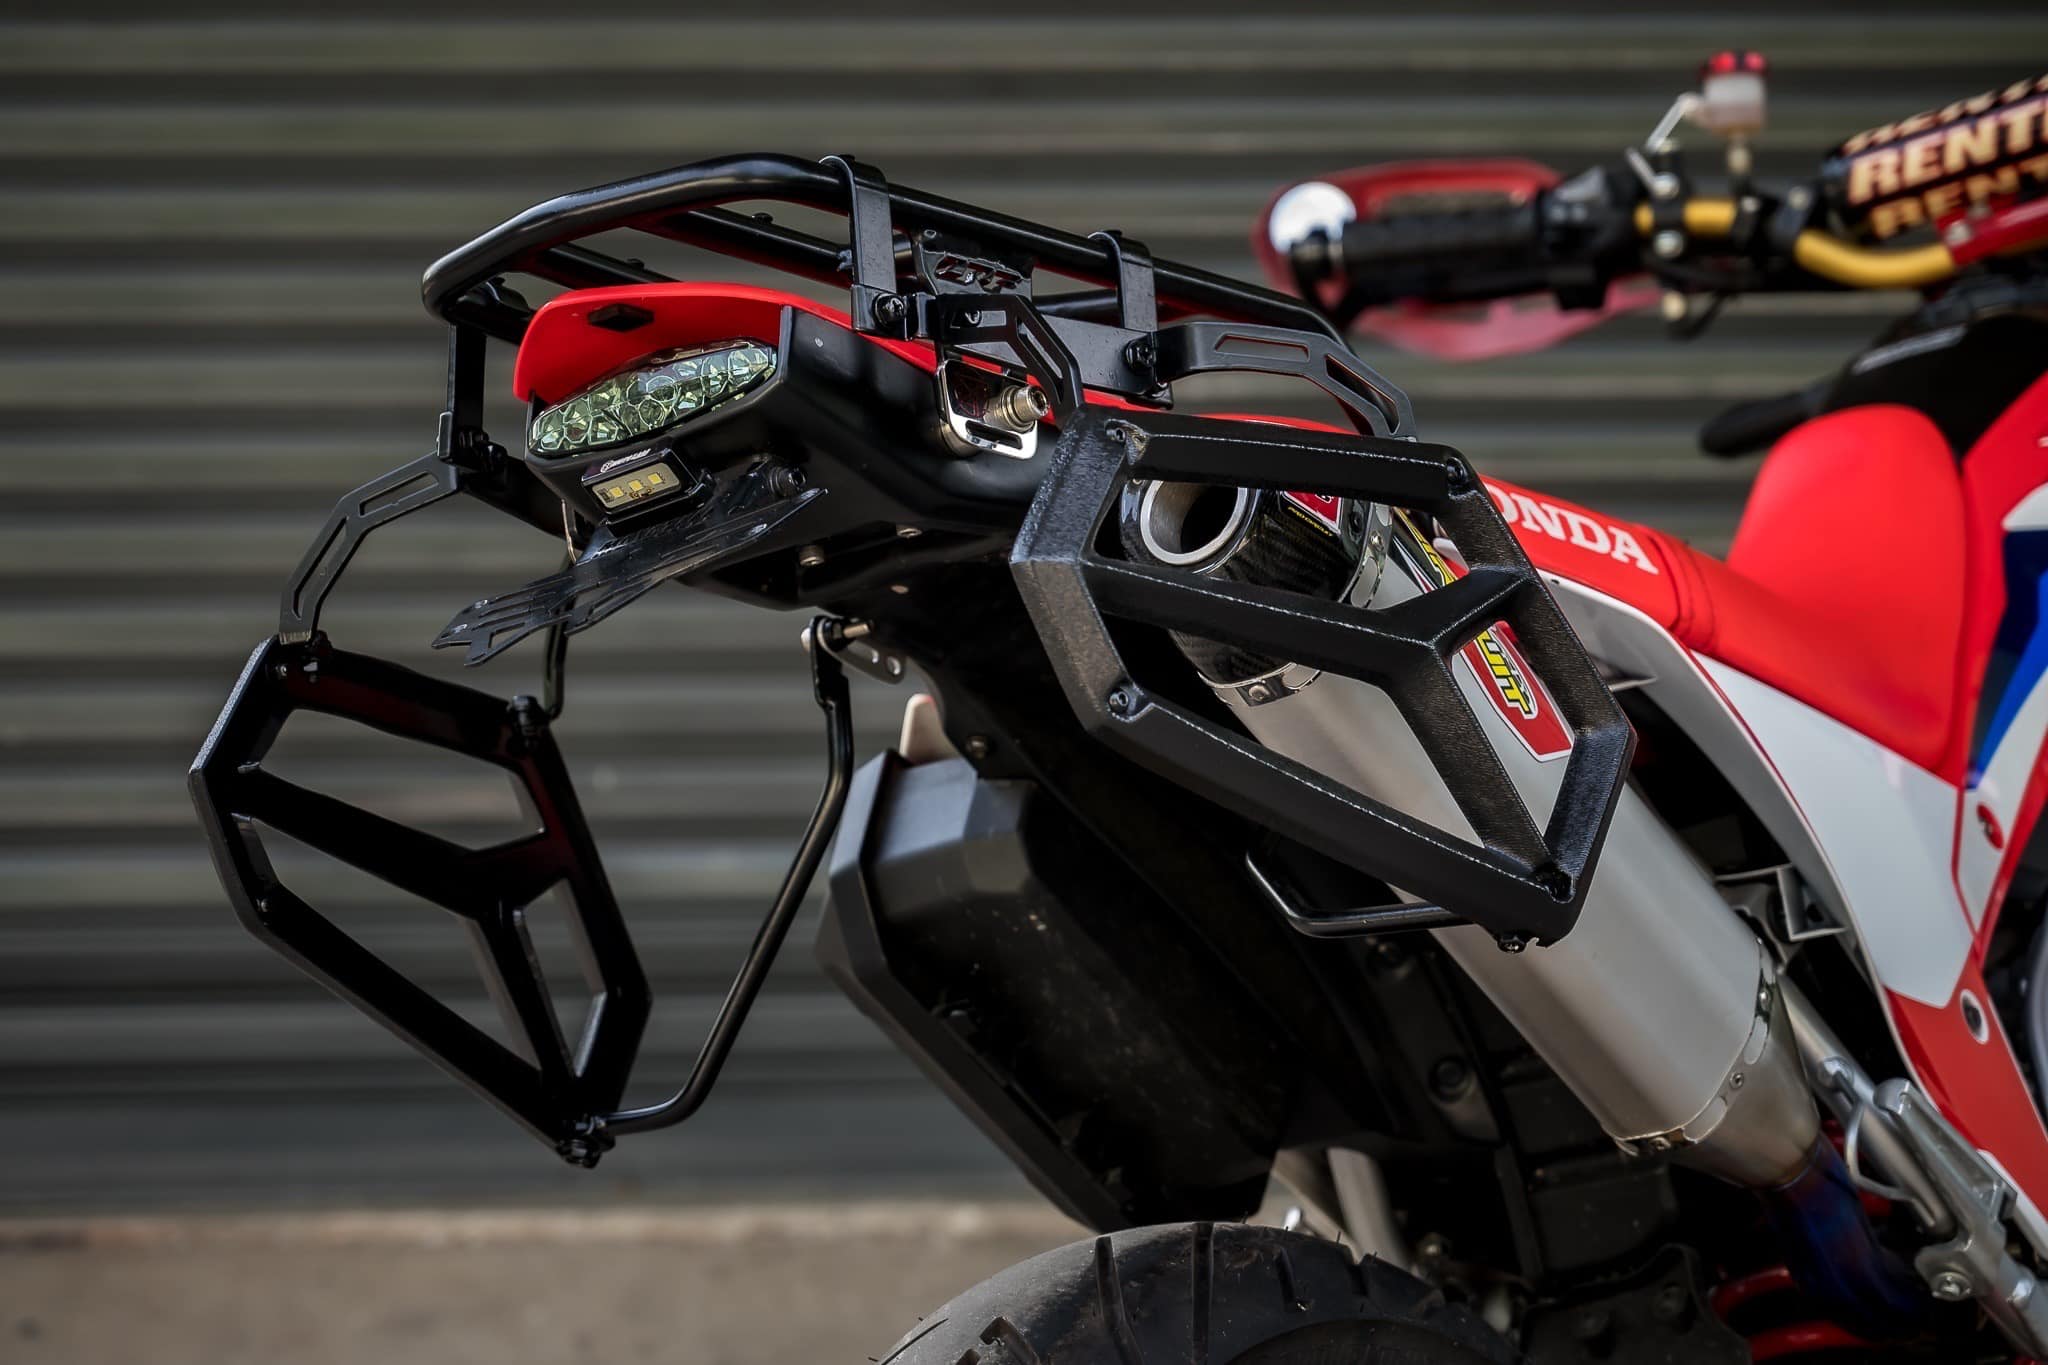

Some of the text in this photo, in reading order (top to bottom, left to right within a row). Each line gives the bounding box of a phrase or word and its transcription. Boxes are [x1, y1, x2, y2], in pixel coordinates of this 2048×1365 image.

[1849, 97, 2048, 206] RENT
[1485, 482, 1660, 575] ONDA
[1477, 630, 1532, 714] UIT
